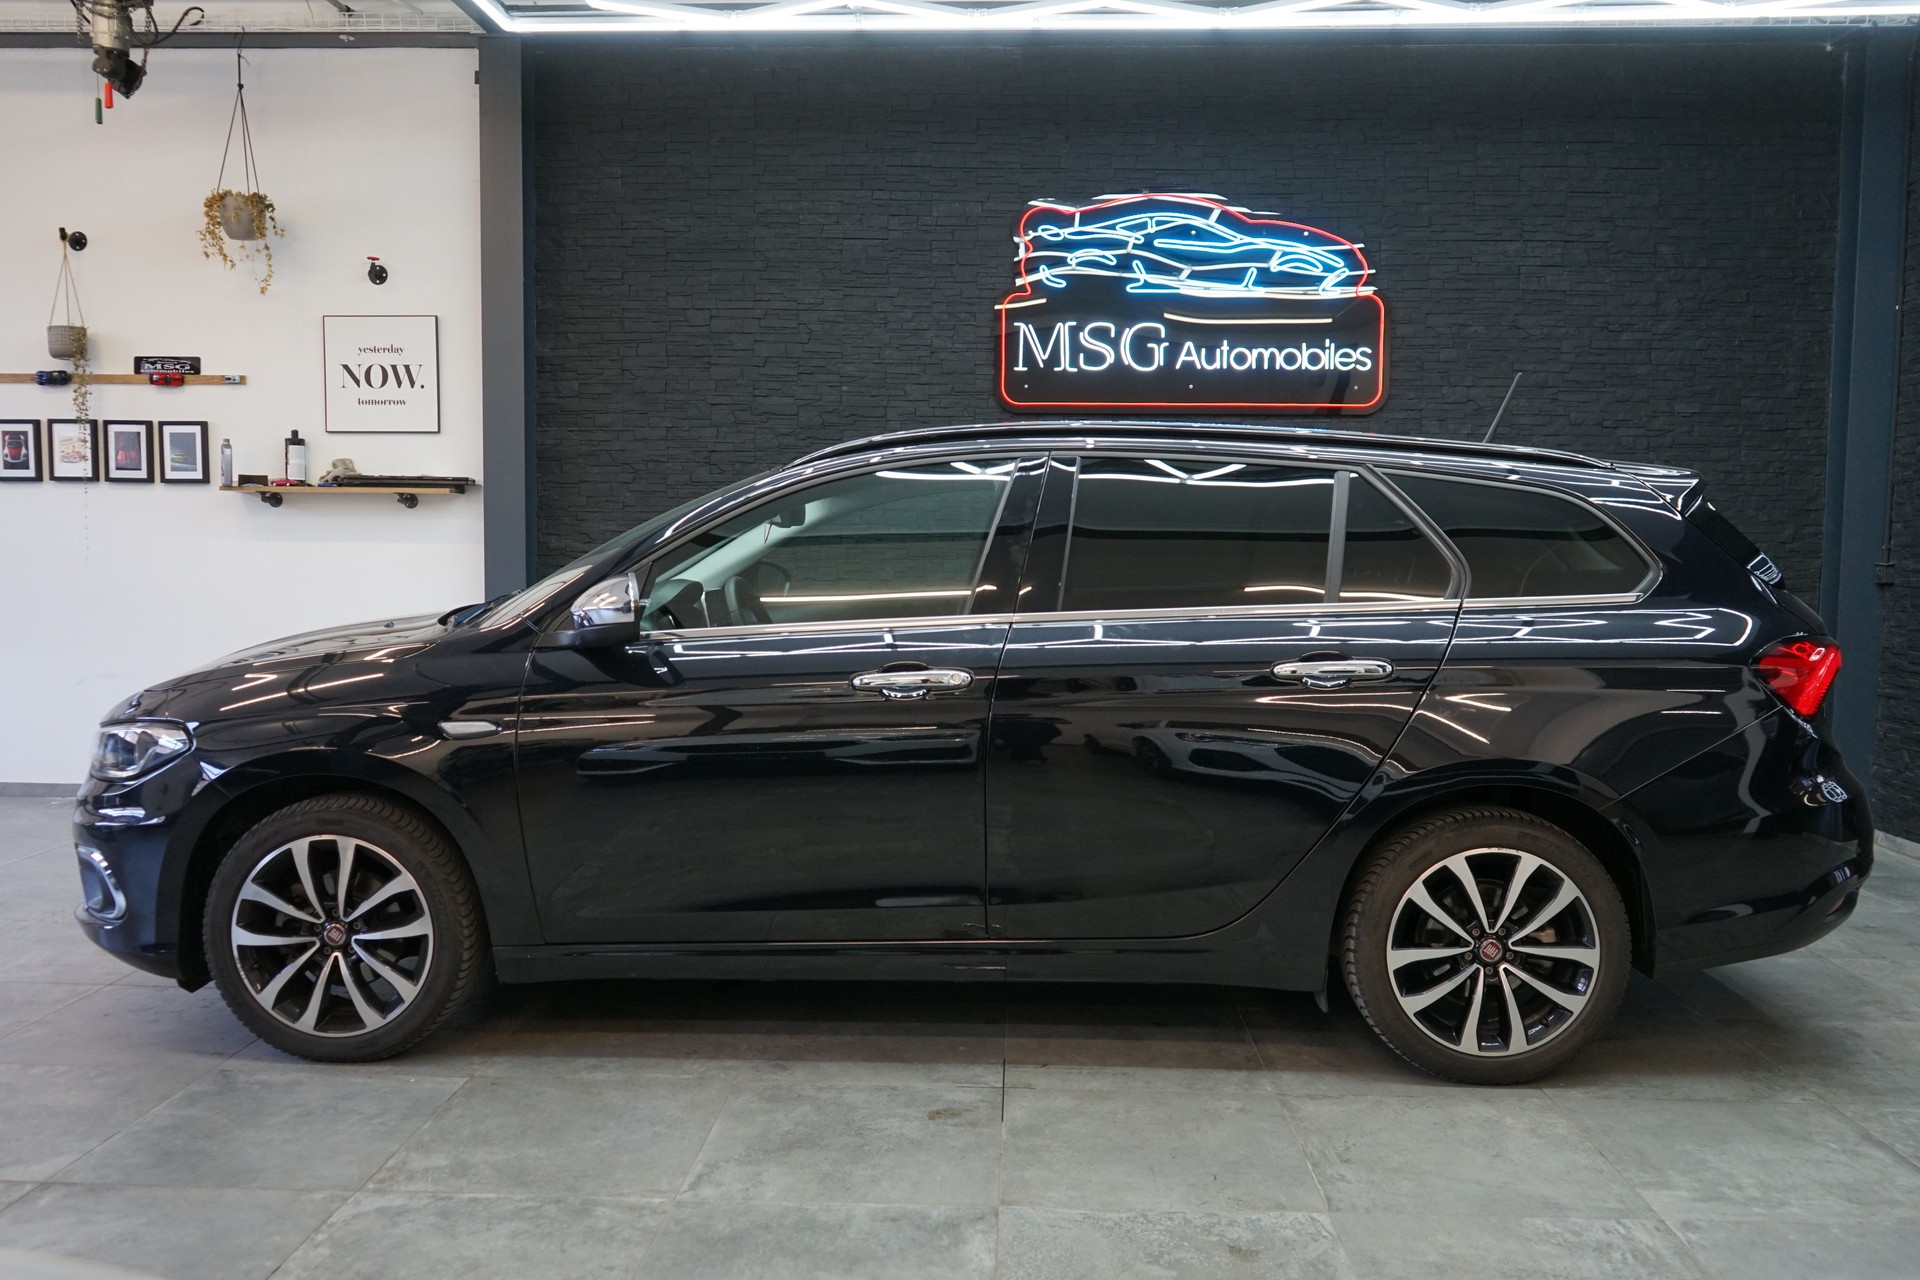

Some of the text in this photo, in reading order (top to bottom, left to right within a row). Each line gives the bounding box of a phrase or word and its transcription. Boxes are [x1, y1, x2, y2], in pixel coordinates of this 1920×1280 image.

[357, 344, 405, 356] yesterday
[1013, 321, 1373, 373] MSG Automobiles
[339, 363, 425, 389] NOW.
[357, 397, 408, 406] tomorrow
